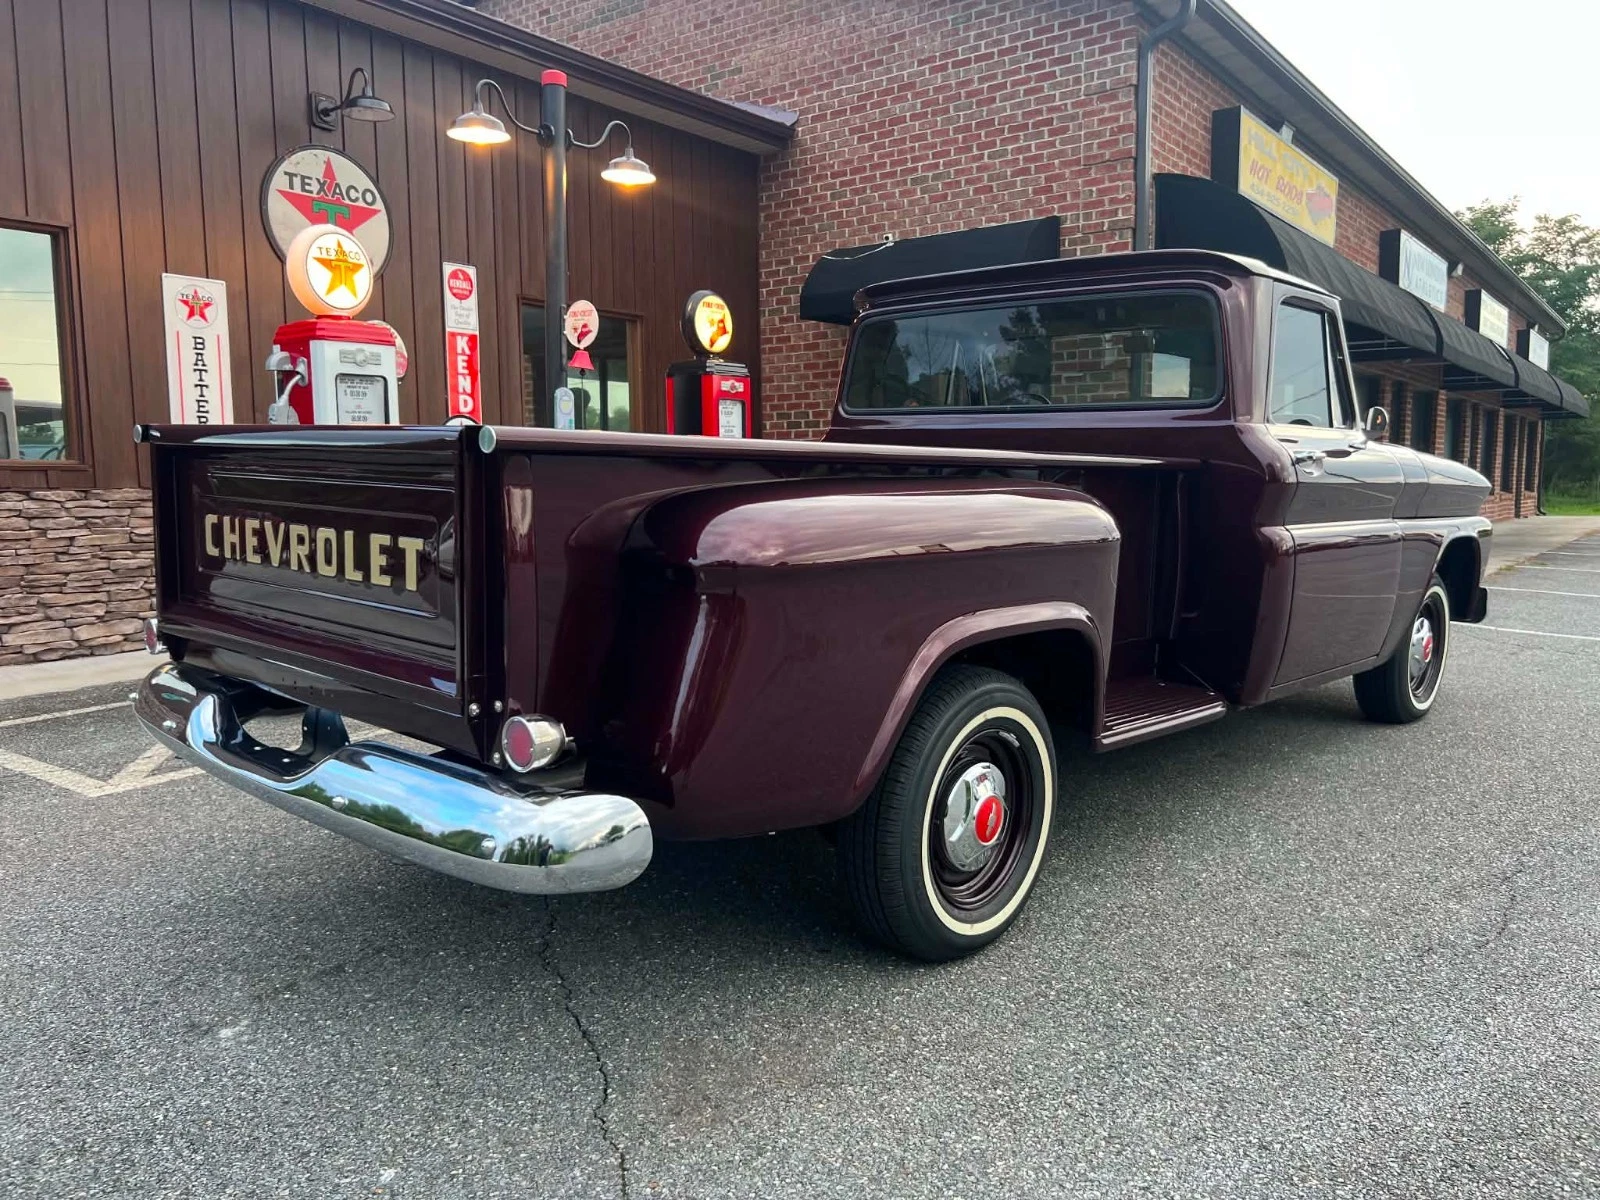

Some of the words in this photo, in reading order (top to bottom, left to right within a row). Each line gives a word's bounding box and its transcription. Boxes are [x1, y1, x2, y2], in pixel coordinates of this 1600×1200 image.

[1249, 158, 1272, 185] HOT
[283, 171, 377, 206] TEXACO
[317, 246, 361, 261] TEXACO
[180, 292, 213, 303] TEXACO
[456, 335, 474, 413] KEND
[205, 514, 424, 591] CHEVROLET
